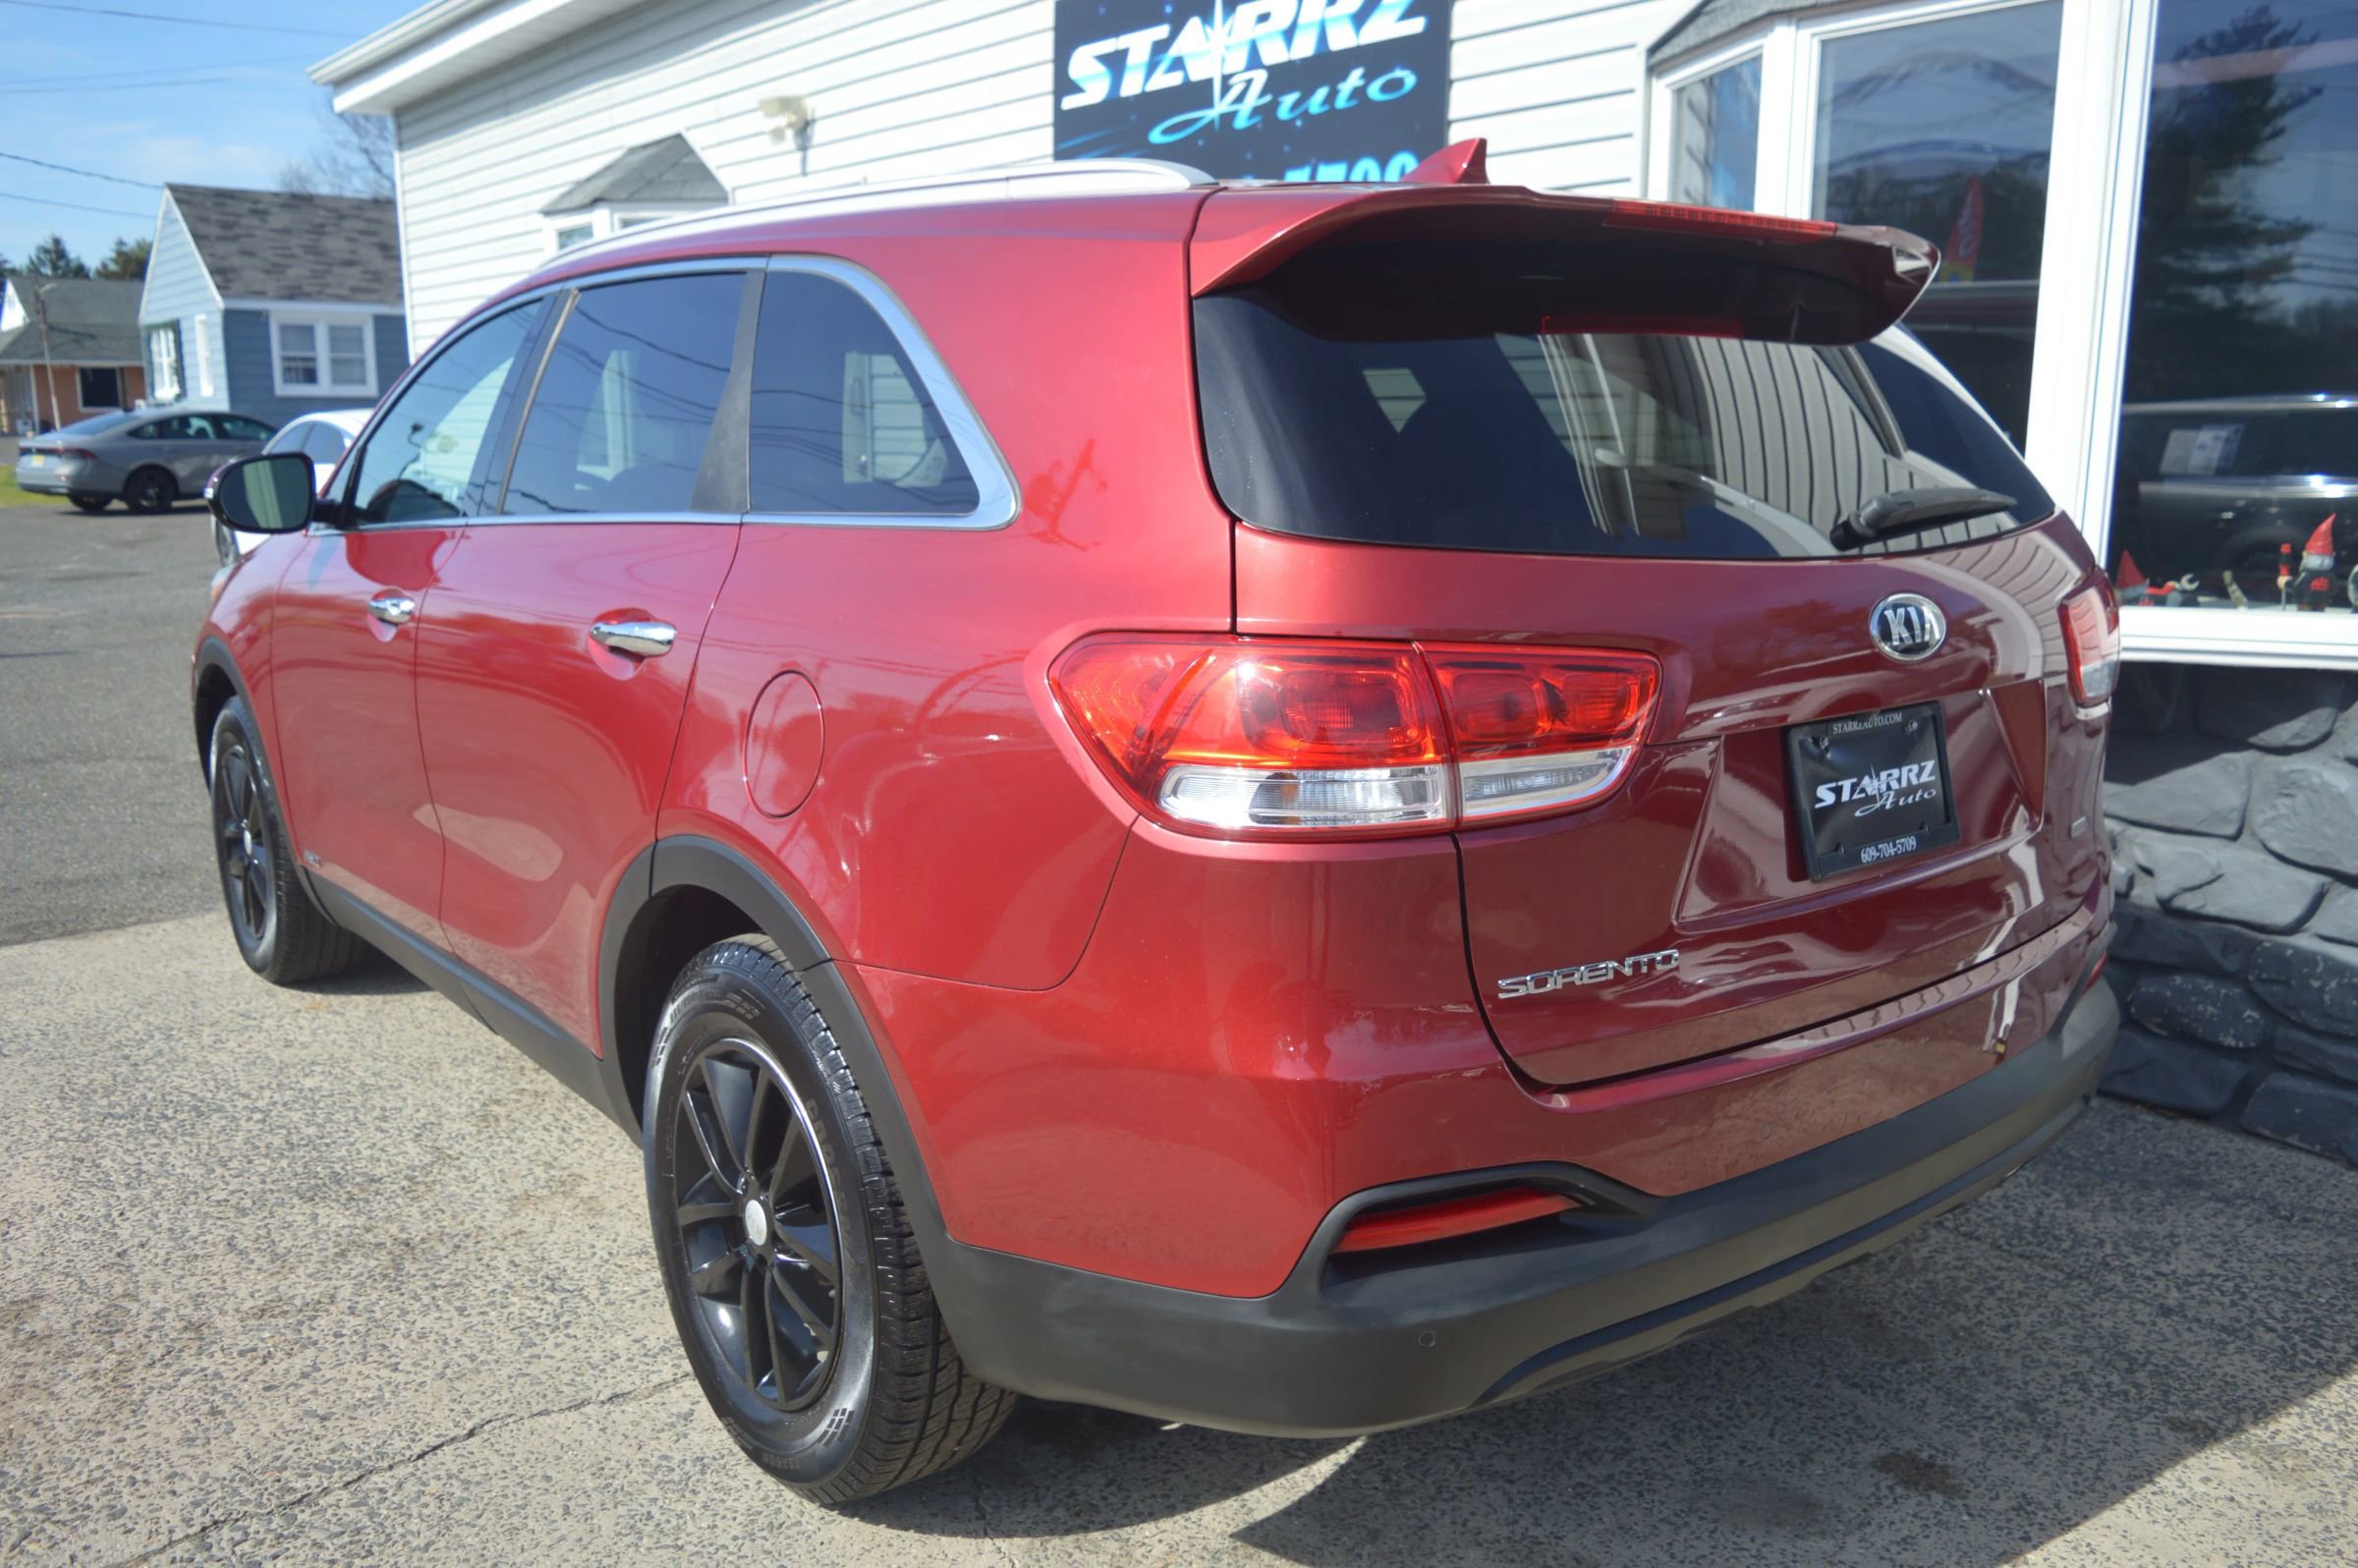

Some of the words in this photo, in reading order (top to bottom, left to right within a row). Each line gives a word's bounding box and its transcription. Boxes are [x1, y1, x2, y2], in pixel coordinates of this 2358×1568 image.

[1148, 66, 1418, 144] Auto
[1883, 606, 1940, 645] KIA
[1815, 759, 1936, 809] STARRZ
[1854, 788, 1937, 817] Auto
[1861, 835, 1917, 863] 609-704-5709
[1497, 949, 1679, 999] SORENTO
